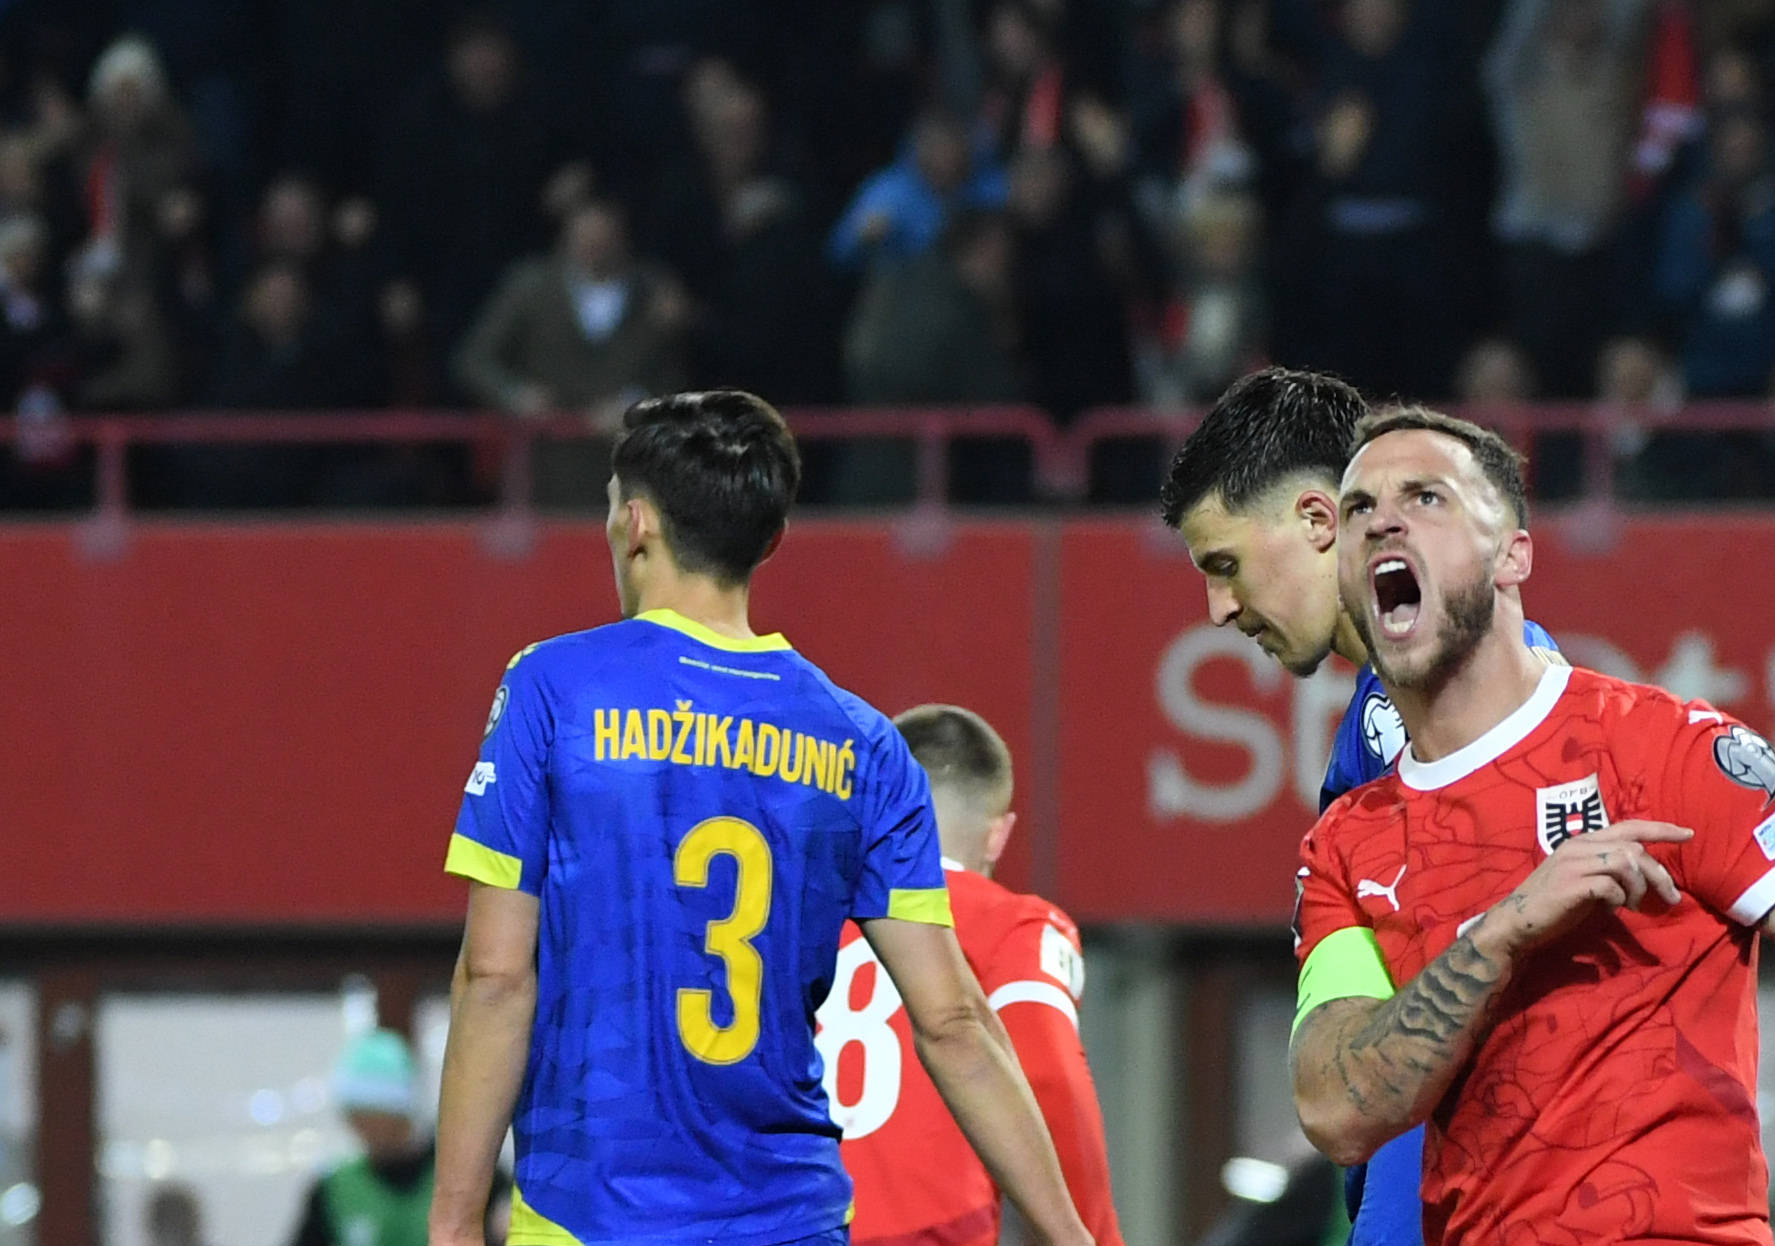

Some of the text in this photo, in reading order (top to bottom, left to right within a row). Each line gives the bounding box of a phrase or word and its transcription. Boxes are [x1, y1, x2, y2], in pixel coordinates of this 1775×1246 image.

[593, 699, 856, 801] HADŽIKADUNIĆ
[673, 815, 773, 1067] 3
[813, 935, 904, 1141] 8
